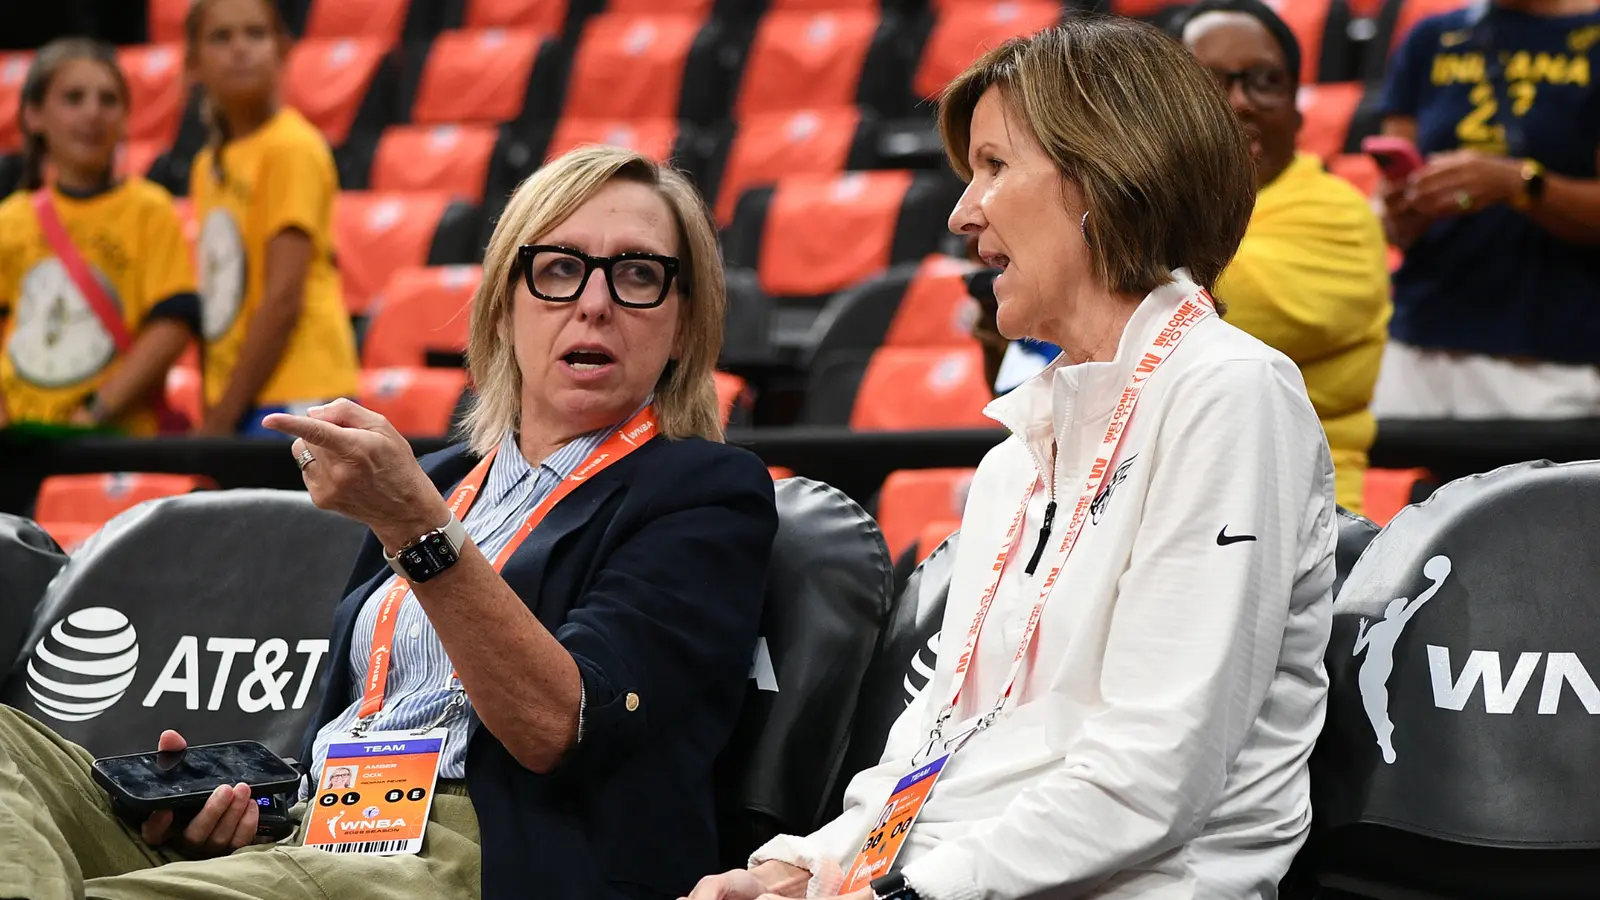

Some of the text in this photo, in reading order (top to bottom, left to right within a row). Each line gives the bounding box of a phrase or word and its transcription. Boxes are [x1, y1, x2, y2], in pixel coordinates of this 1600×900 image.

[1431, 51, 1591, 86] INANA
[1152, 299, 1197, 348] WELCOME
[1163, 307, 1206, 348] TO THE
[1135, 352, 1163, 374] W
[628, 420, 654, 440] WNBA
[1103, 386, 1134, 444] WELCOME
[577, 453, 610, 475] WNBA
[1089, 457, 1109, 480] W
[451, 489, 469, 514] WNB
[1059, 496, 1088, 553] WELCOME
[381, 590, 399, 624] WNBA
[142, 635, 330, 713] AT&T
[370, 653, 383, 691] WNBA
[1426, 644, 1600, 715] WN
[364, 744, 406, 753] TEAM
[340, 818, 407, 831] WNBA
